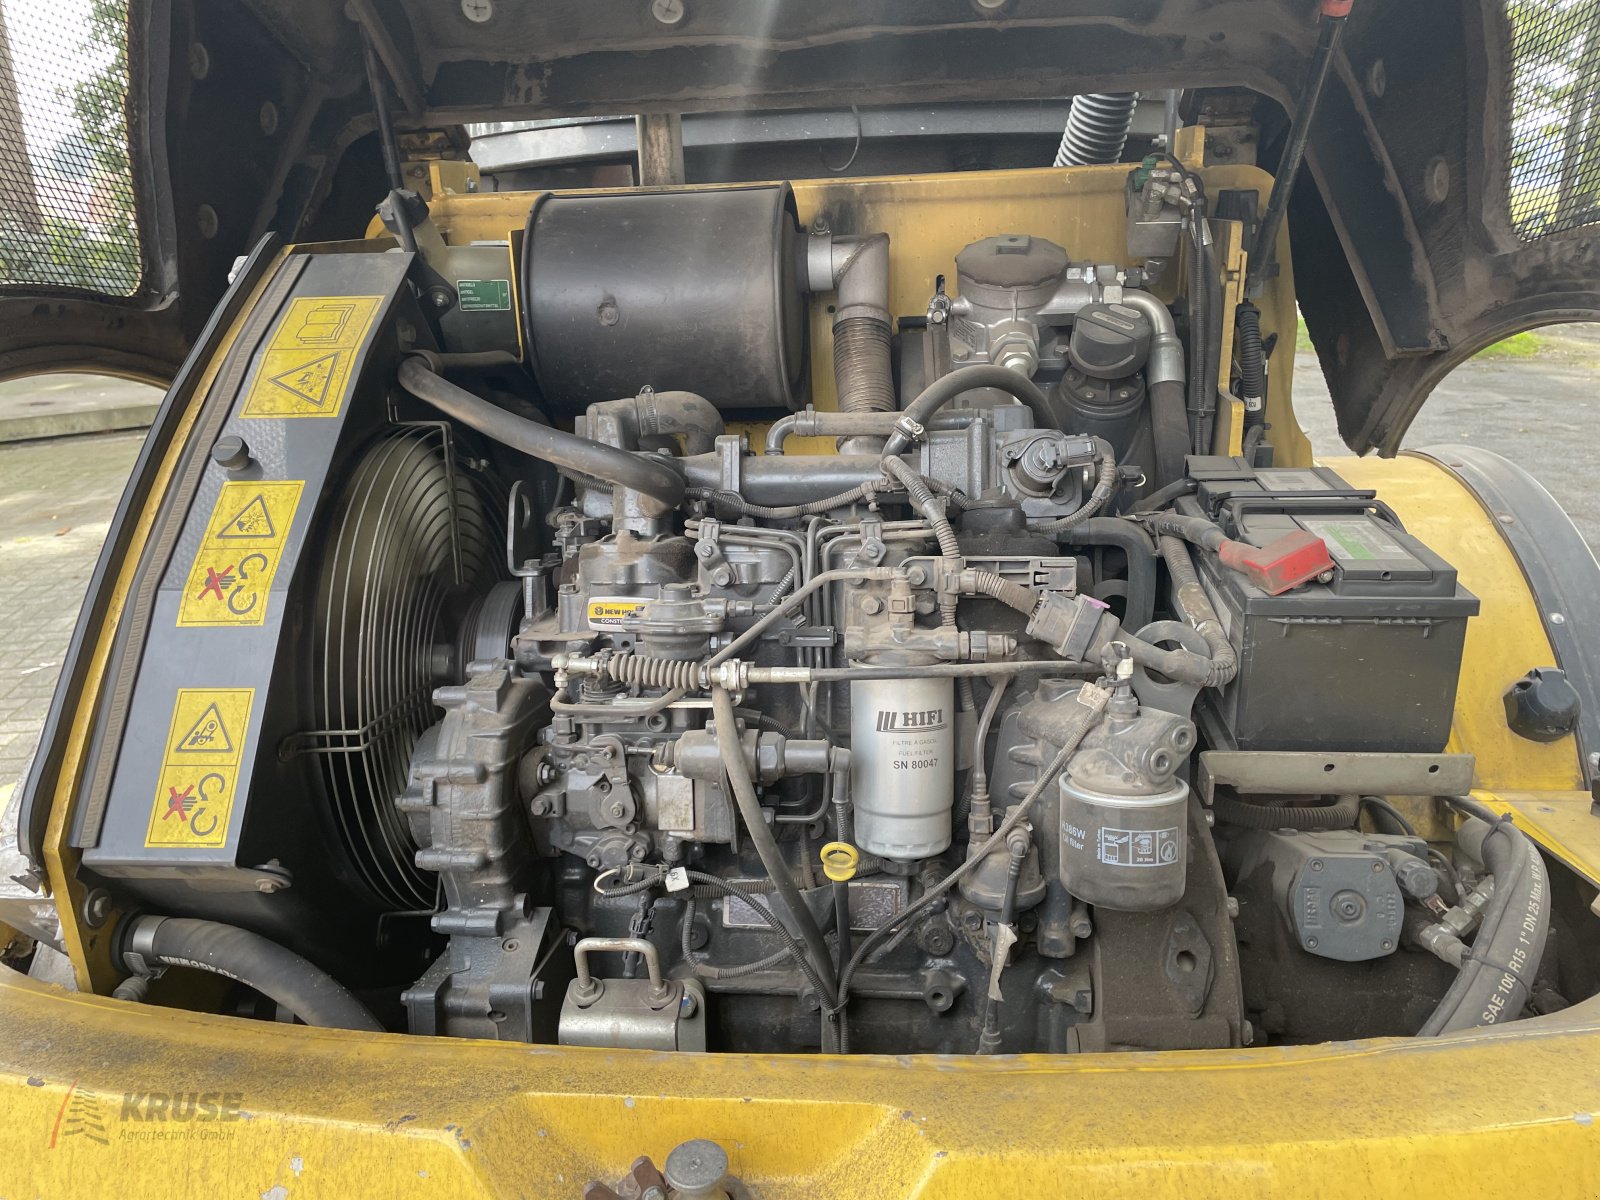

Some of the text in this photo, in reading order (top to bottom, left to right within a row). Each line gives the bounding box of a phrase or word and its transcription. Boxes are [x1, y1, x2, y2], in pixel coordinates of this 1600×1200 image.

[902, 709, 943, 726] HIFI
[893, 758, 938, 769] SN 80047
[1483, 994, 1505, 1024] SAE
[1499, 973, 1516, 994] 100
[1509, 948, 1526, 974] R15
[1523, 914, 1536, 934] DN
[1530, 903, 1540, 919] 25
